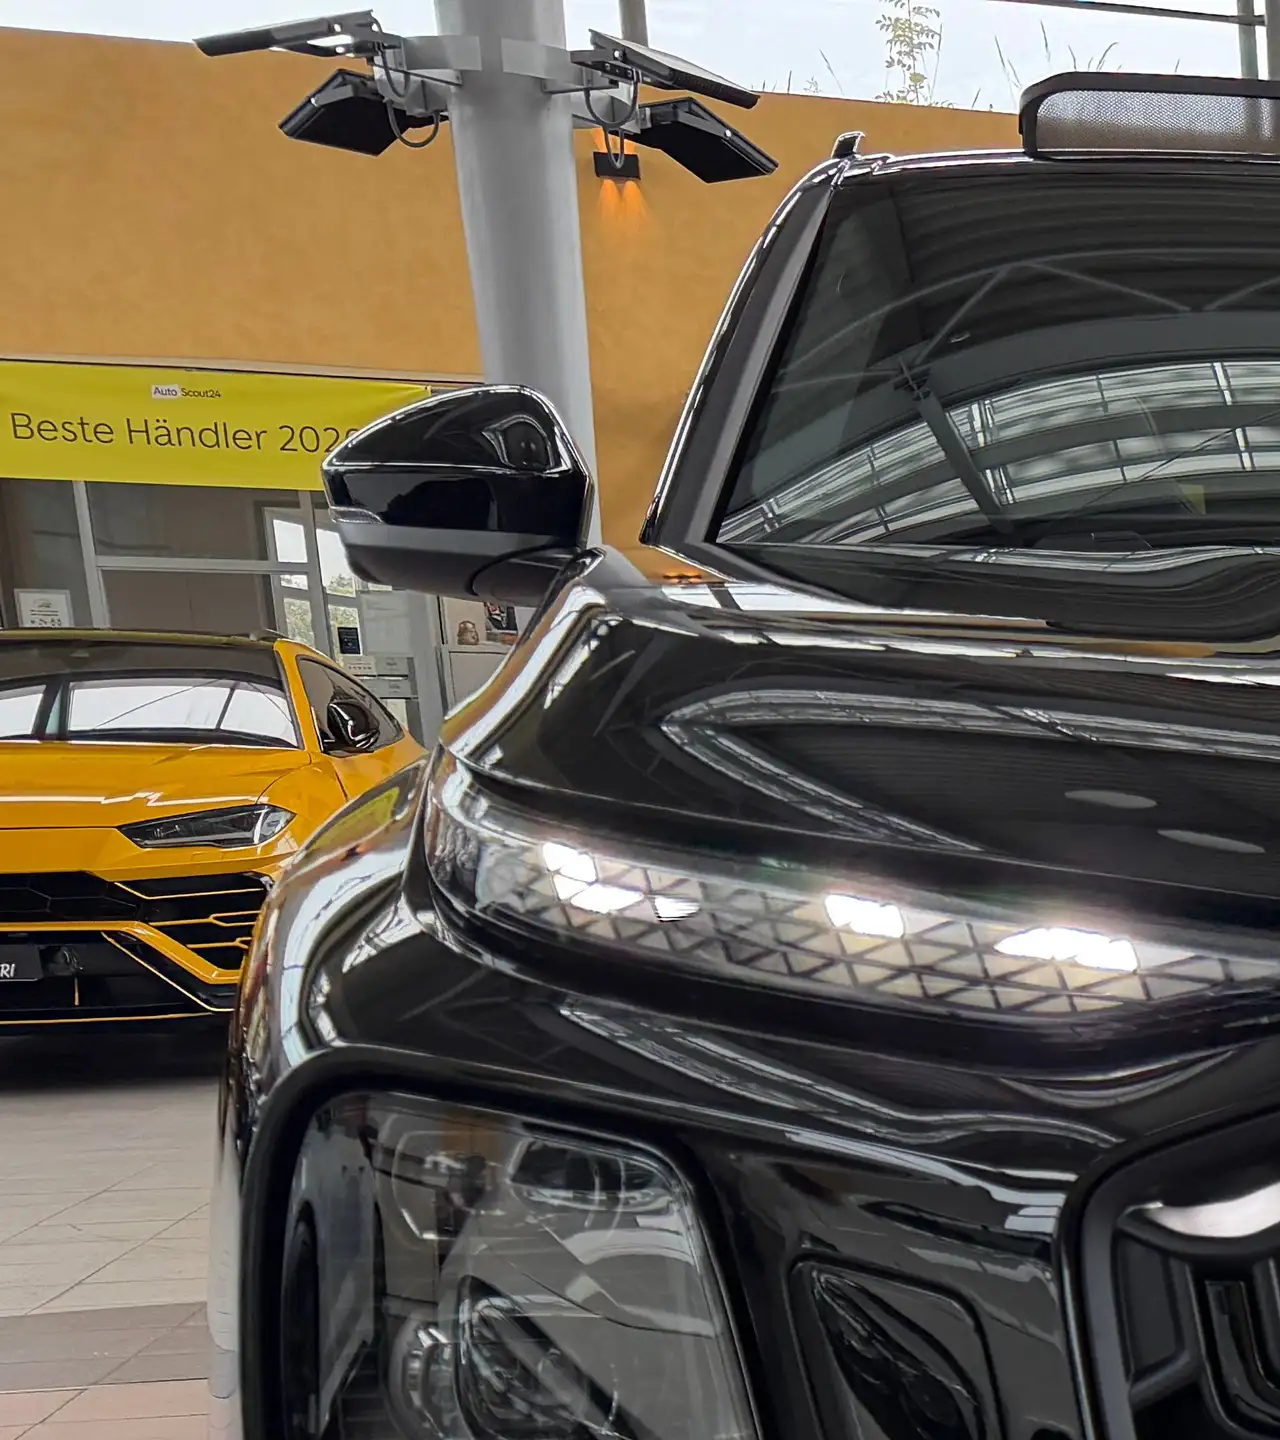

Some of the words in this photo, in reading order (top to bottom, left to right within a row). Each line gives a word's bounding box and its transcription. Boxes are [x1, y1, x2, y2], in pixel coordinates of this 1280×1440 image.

[153, 385, 178, 397] Auto
[181, 387, 222, 399] Scout24
[10, 412, 114, 444] Beste
[125, 417, 267, 451] Händler
